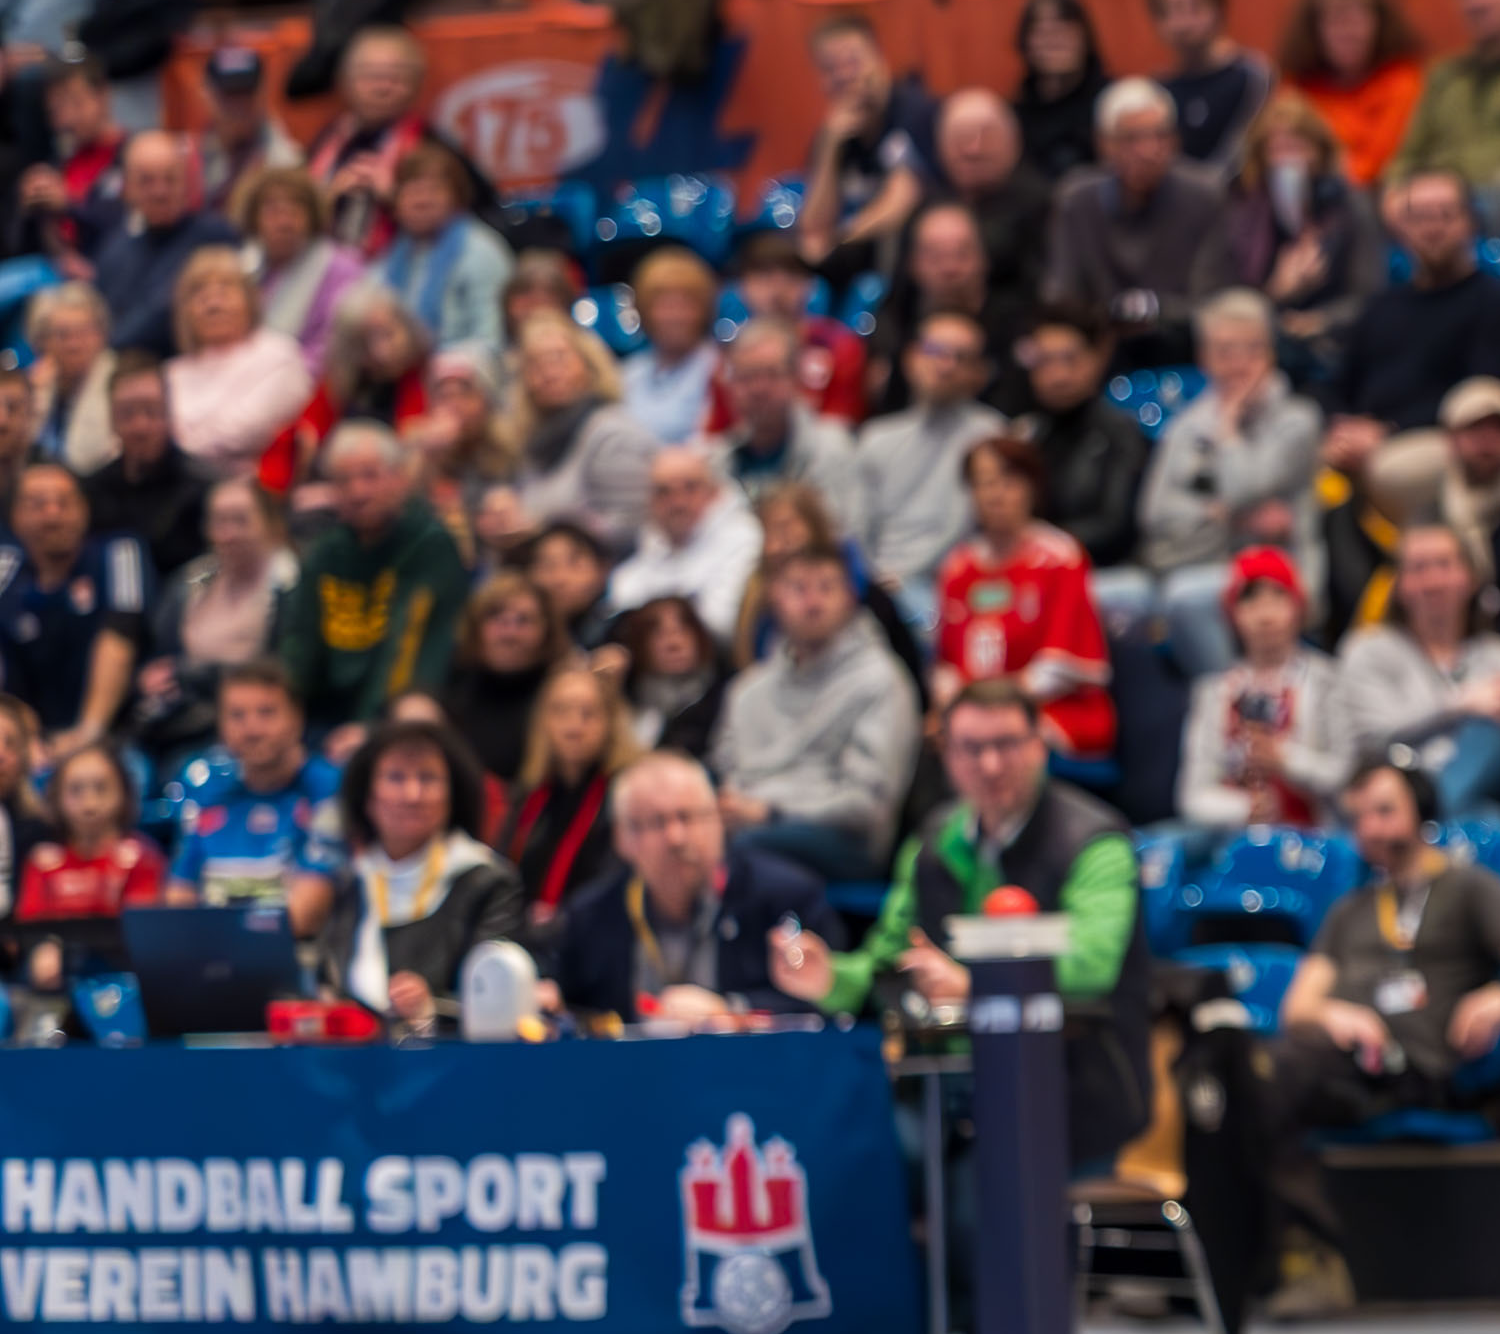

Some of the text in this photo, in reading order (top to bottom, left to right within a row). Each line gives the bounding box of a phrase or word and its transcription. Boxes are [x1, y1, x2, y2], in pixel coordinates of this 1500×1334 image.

[3, 1153, 606, 1234] HANDBALL SPORT
[0, 1243, 608, 1322] VEREIN HAMBURG
